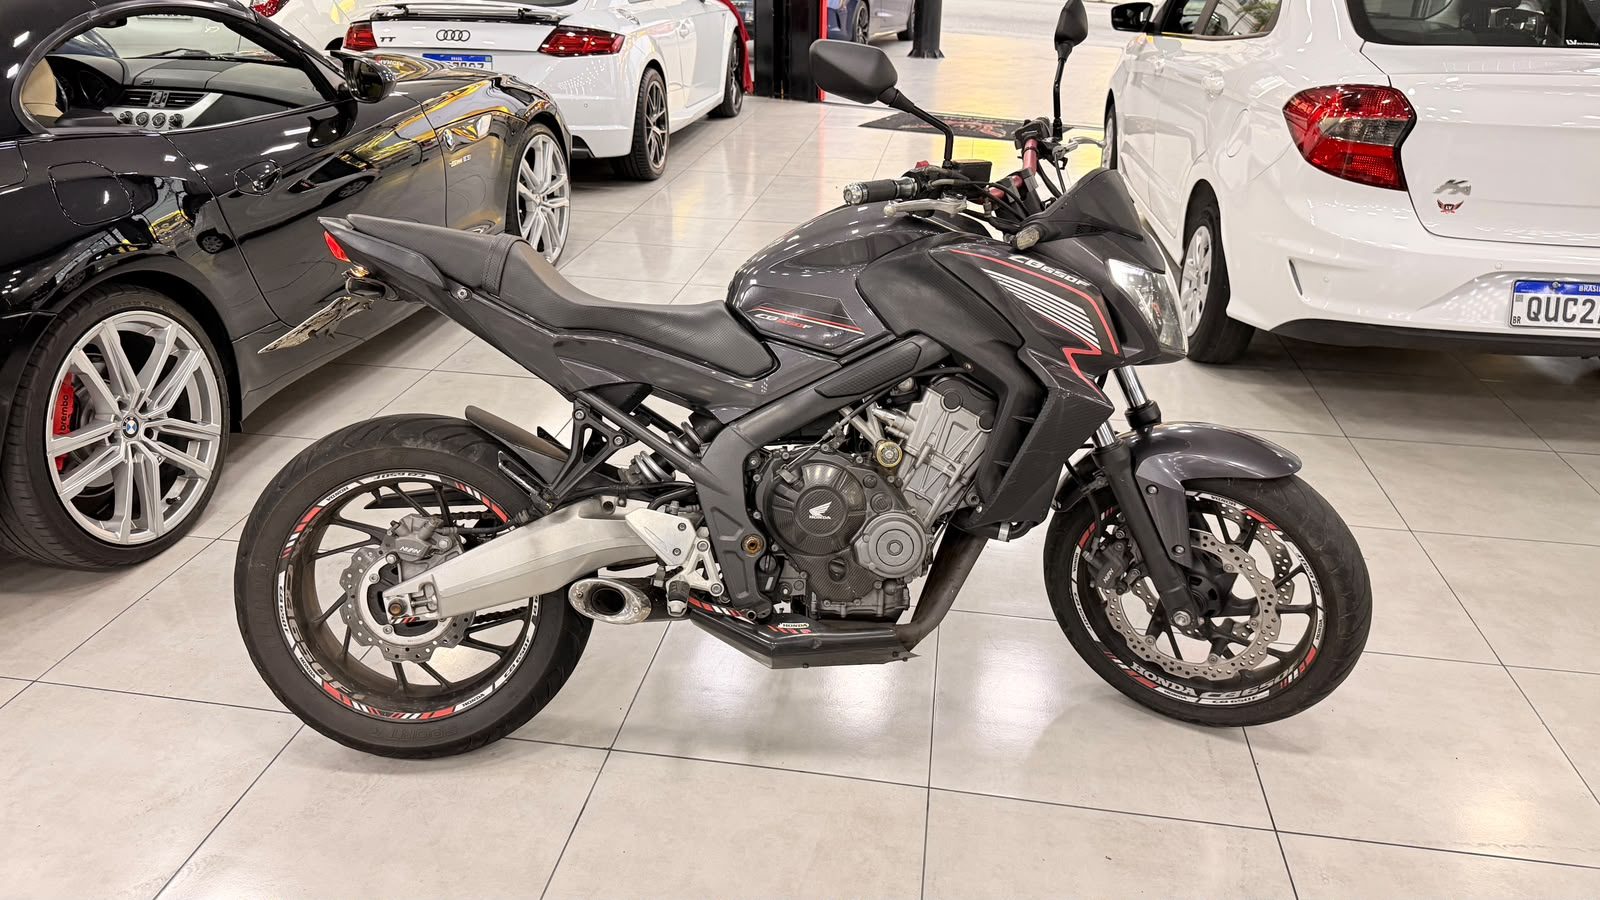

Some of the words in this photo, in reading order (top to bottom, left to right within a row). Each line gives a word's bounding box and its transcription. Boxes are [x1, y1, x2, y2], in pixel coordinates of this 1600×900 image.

[1008, 254, 1091, 287] CB650F
[1512, 316, 1521, 324] BR
[1527, 296, 1600, 324] QUC2
[61, 394, 69, 431] brembo
[326, 486, 349, 502] HONDA
[1314, 619, 1324, 641] HONDA
[300, 656, 316, 679] HONDA
[1130, 661, 1198, 697] HONDA
[1200, 660, 1301, 699] CB650F
[462, 692, 486, 708] HONDA
